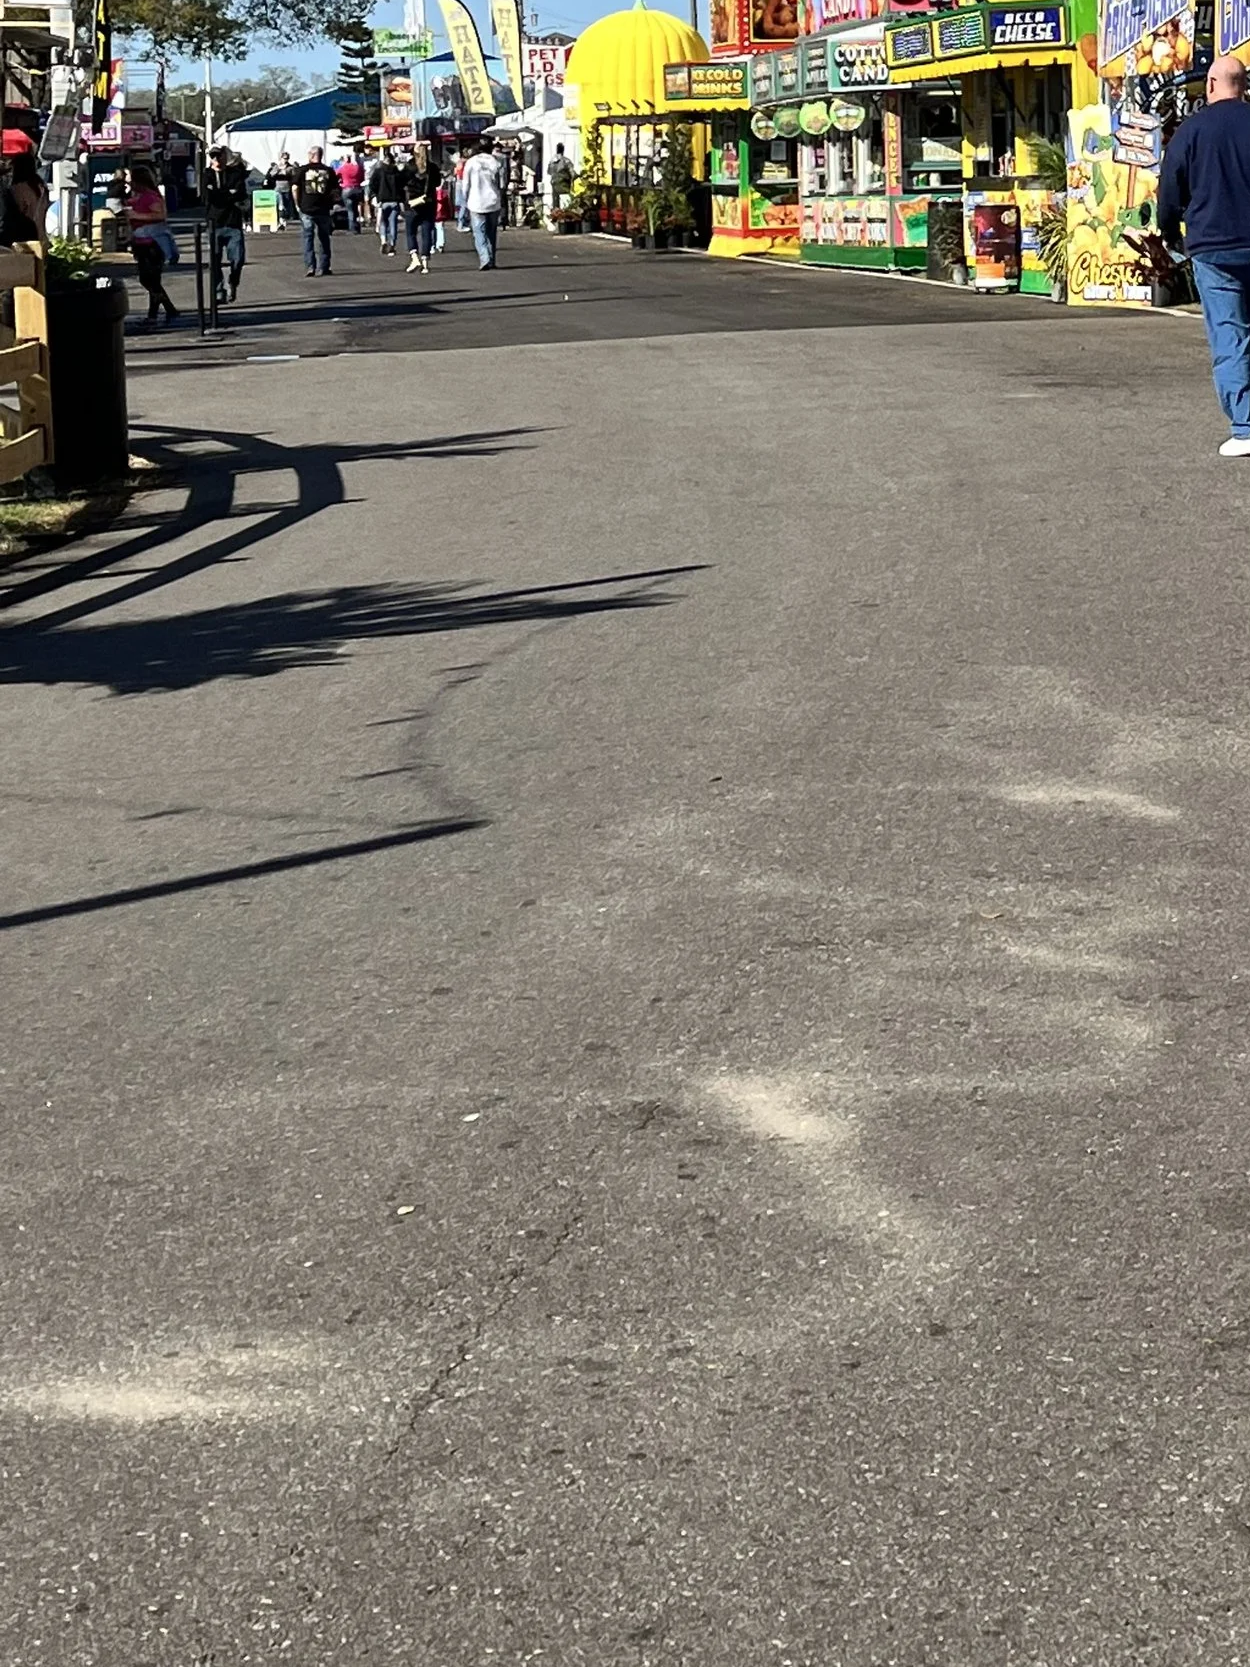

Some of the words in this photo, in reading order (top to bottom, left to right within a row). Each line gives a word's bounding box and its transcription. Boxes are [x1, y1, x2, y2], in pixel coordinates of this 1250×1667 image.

[994, 22, 1057, 43] CHEESE
[528, 48, 559, 60] PET
[706, 68, 743, 81] COLD
[840, 63, 889, 82] CAND
[691, 82, 743, 94] DRINKS
